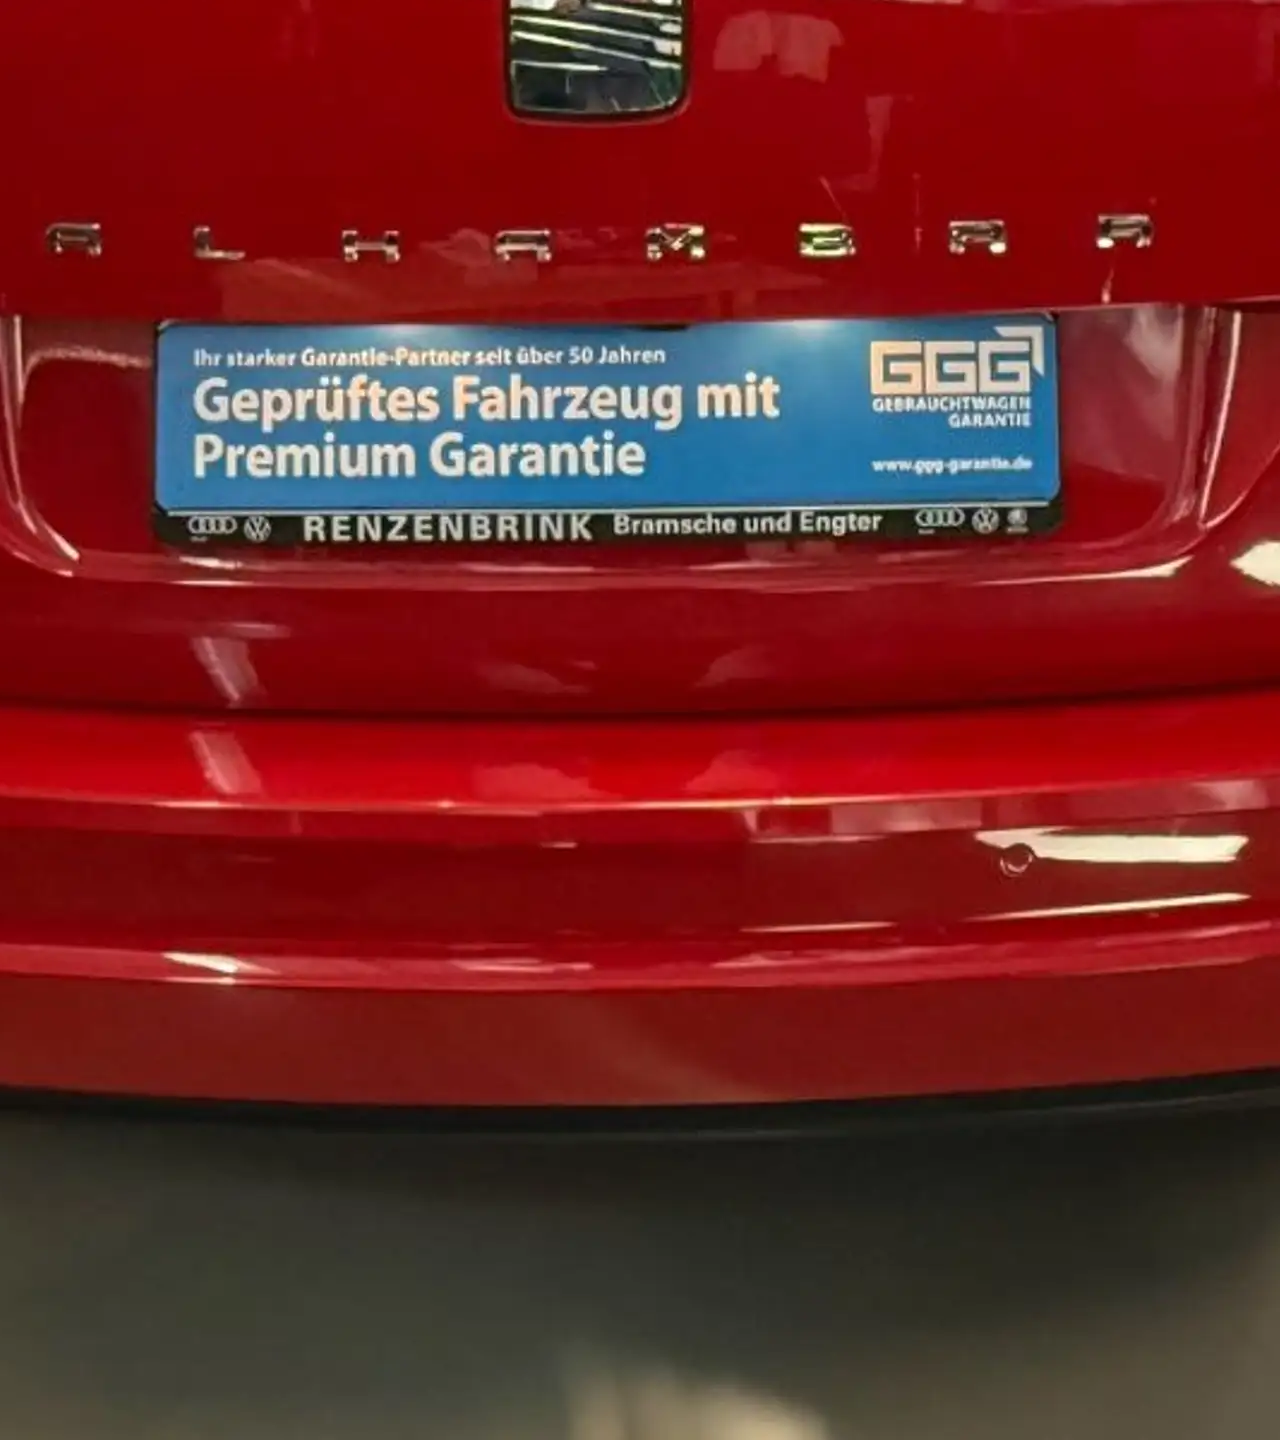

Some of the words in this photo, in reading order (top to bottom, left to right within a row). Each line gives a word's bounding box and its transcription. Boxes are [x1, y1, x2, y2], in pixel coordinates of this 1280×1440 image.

[45, 212, 1153, 263] ALHAMBRA
[193, 348, 221, 367] Ihr
[226, 348, 296, 367] starker
[301, 345, 471, 367] Garantie-Partner
[474, 347, 513, 366] seit
[516, 346, 564, 365] über
[568, 346, 594, 364] 50
[597, 345, 667, 365] Jahren
[871, 340, 1031, 396] GGG
[193, 373, 441, 433] Geprüftes
[452, 373, 683, 431] Fahrzeug
[697, 370, 781, 419] mit
[871, 395, 1032, 414] GEBRAUCHTWAGEN
[948, 413, 1032, 429] GARANTIE
[193, 431, 417, 479] Premium
[429, 428, 647, 478] Garantie
[871, 455, 1034, 475] www.ggg-garantie.de
[303, 513, 594, 543] RENZENBRINK
[613, 510, 736, 536] Bramsche
[742, 510, 793, 534] und
[798, 509, 883, 537] Engter
